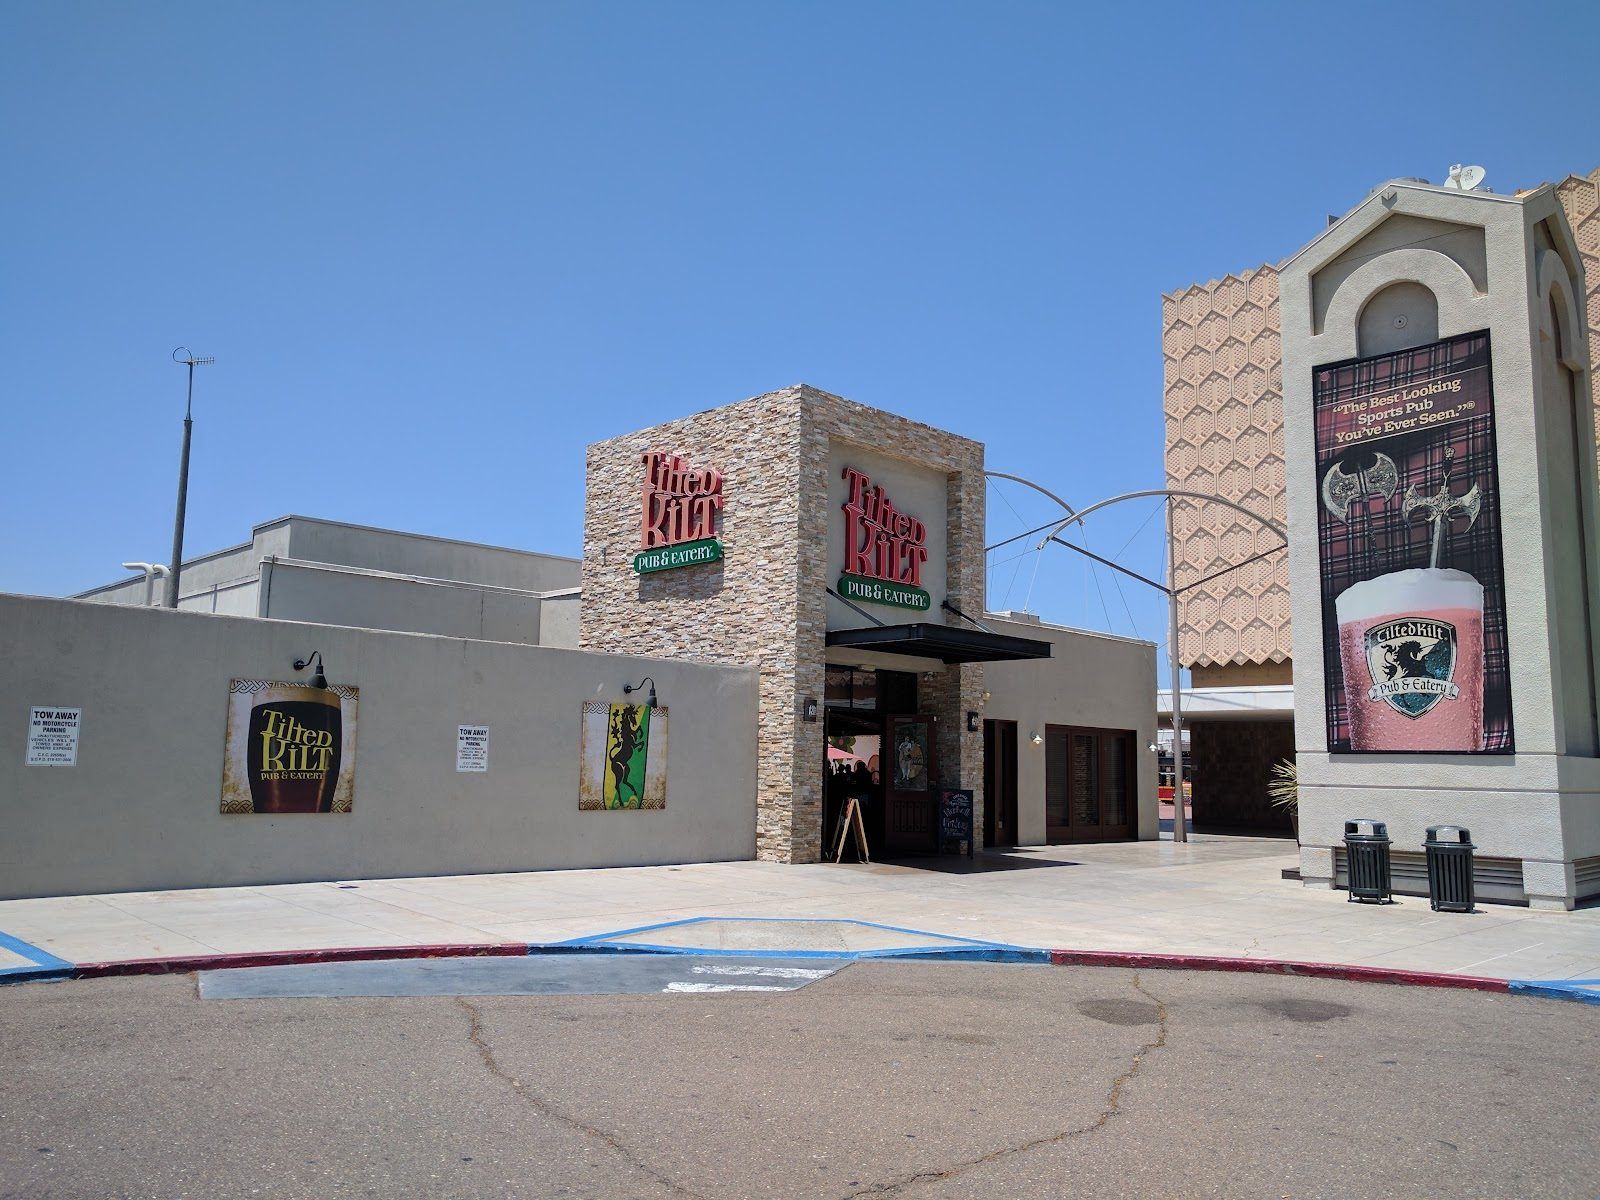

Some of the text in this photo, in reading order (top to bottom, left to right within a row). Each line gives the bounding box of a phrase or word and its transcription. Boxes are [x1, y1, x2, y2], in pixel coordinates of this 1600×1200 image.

[1333, 378, 1462, 415] “The Best Looking
[1358, 399, 1434, 426] Sports Pub
[1335, 425, 1382, 443] You’ve
[1384, 416, 1418, 433] Ever
[638, 555, 660, 570] PUB
[661, 551, 669, 566] &
[848, 581, 872, 598] PUB
[873, 581, 882, 600] &
[1377, 622, 1444, 642] Tilted Kilt
[1380, 678, 1447, 694] Pub & Eatery
[34, 711, 78, 720] TOW AWAY
[261, 772, 280, 780] PUB
[281, 771, 288, 780] &
